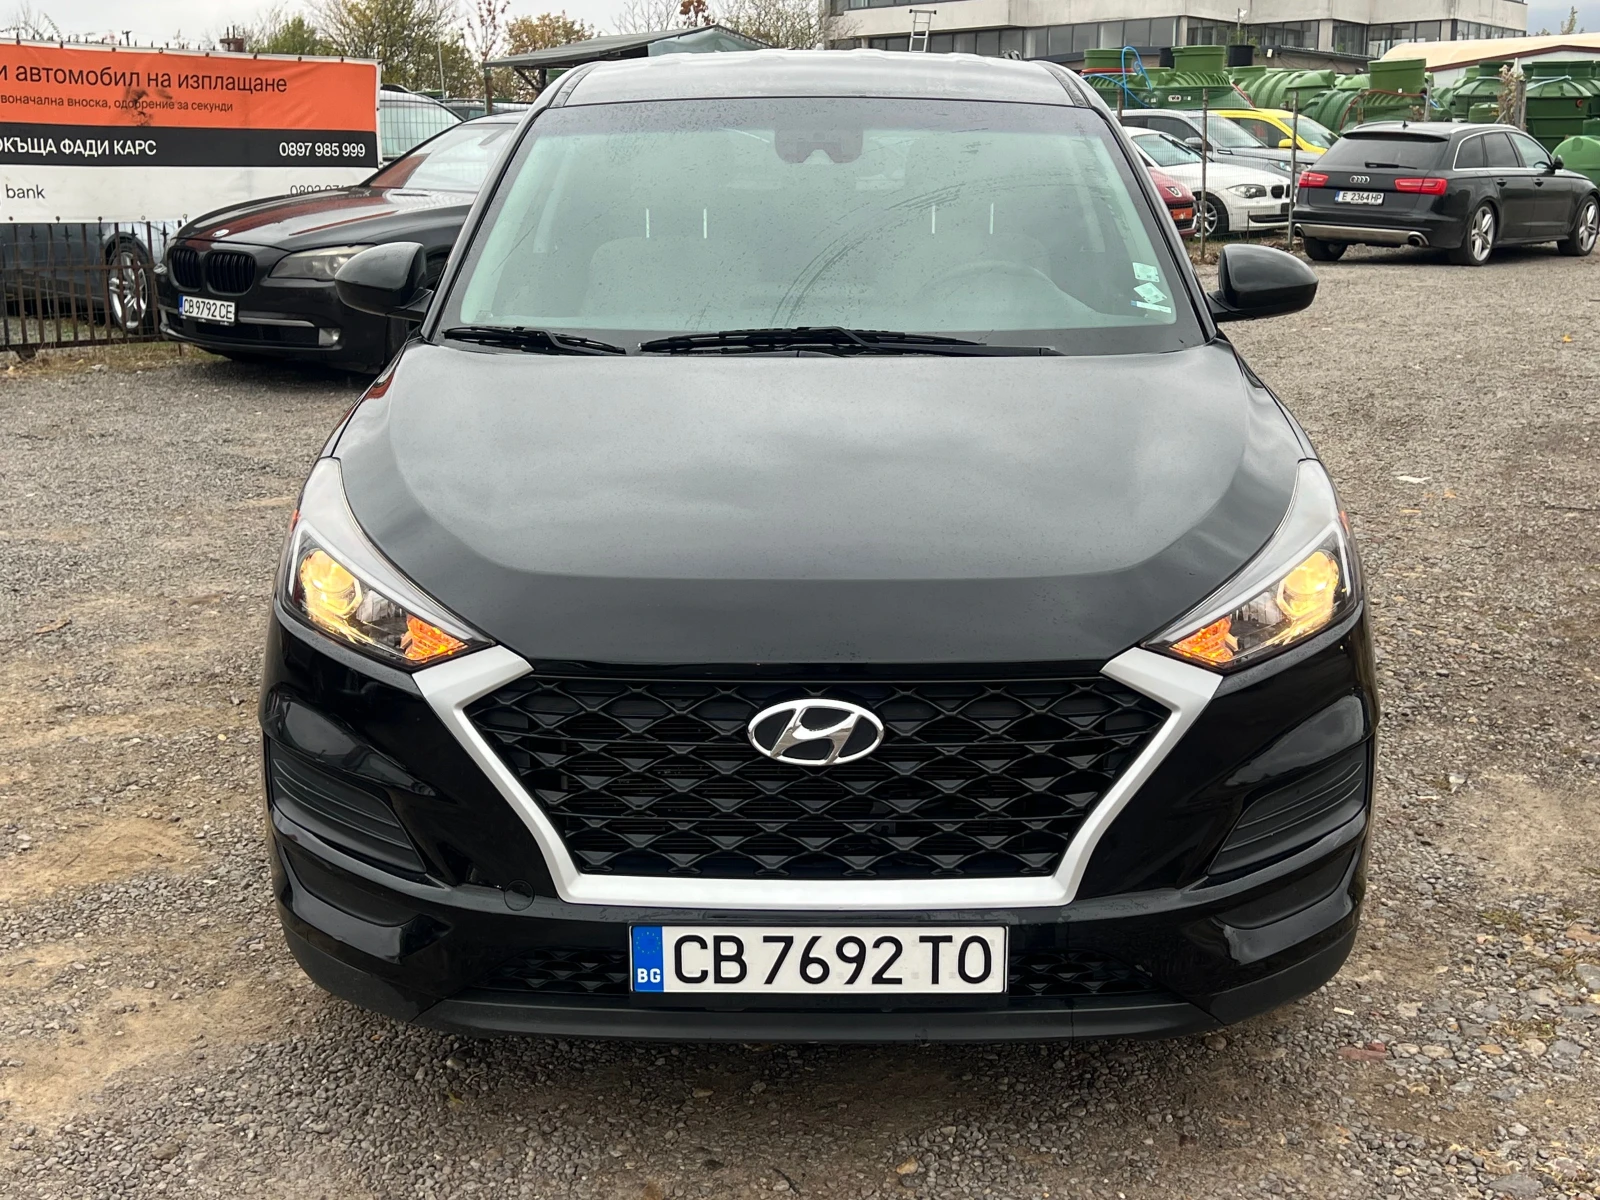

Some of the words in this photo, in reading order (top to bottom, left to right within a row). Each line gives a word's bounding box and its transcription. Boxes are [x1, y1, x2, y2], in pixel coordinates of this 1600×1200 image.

[15, 65, 140, 87] автомобил
[147, 72, 171, 88] на
[178, 74, 287, 94] изплащане
[67, 98, 111, 109] вноска,
[177, 101, 188, 110] за
[191, 102, 233, 113] секунди
[60, 138, 109, 157] ФАДИ
[114, 140, 157, 155] КАРС
[279, 142, 312, 156] 0897
[315, 143, 339, 157] 985
[342, 143, 366, 157] 999
[5, 184, 45, 199] bank
[1342, 192, 1348, 200] E
[1350, 192, 1370, 202] 2364
[1371, 193, 1382, 202] HP
[183, 298, 194, 314] CB
[195, 300, 218, 318] 9792
[219, 303, 233, 320] CE
[673, 934, 748, 985] CB
[762, 935, 903, 985] 7692
[918, 934, 993, 985] TO
[636, 967, 661, 984] BG
